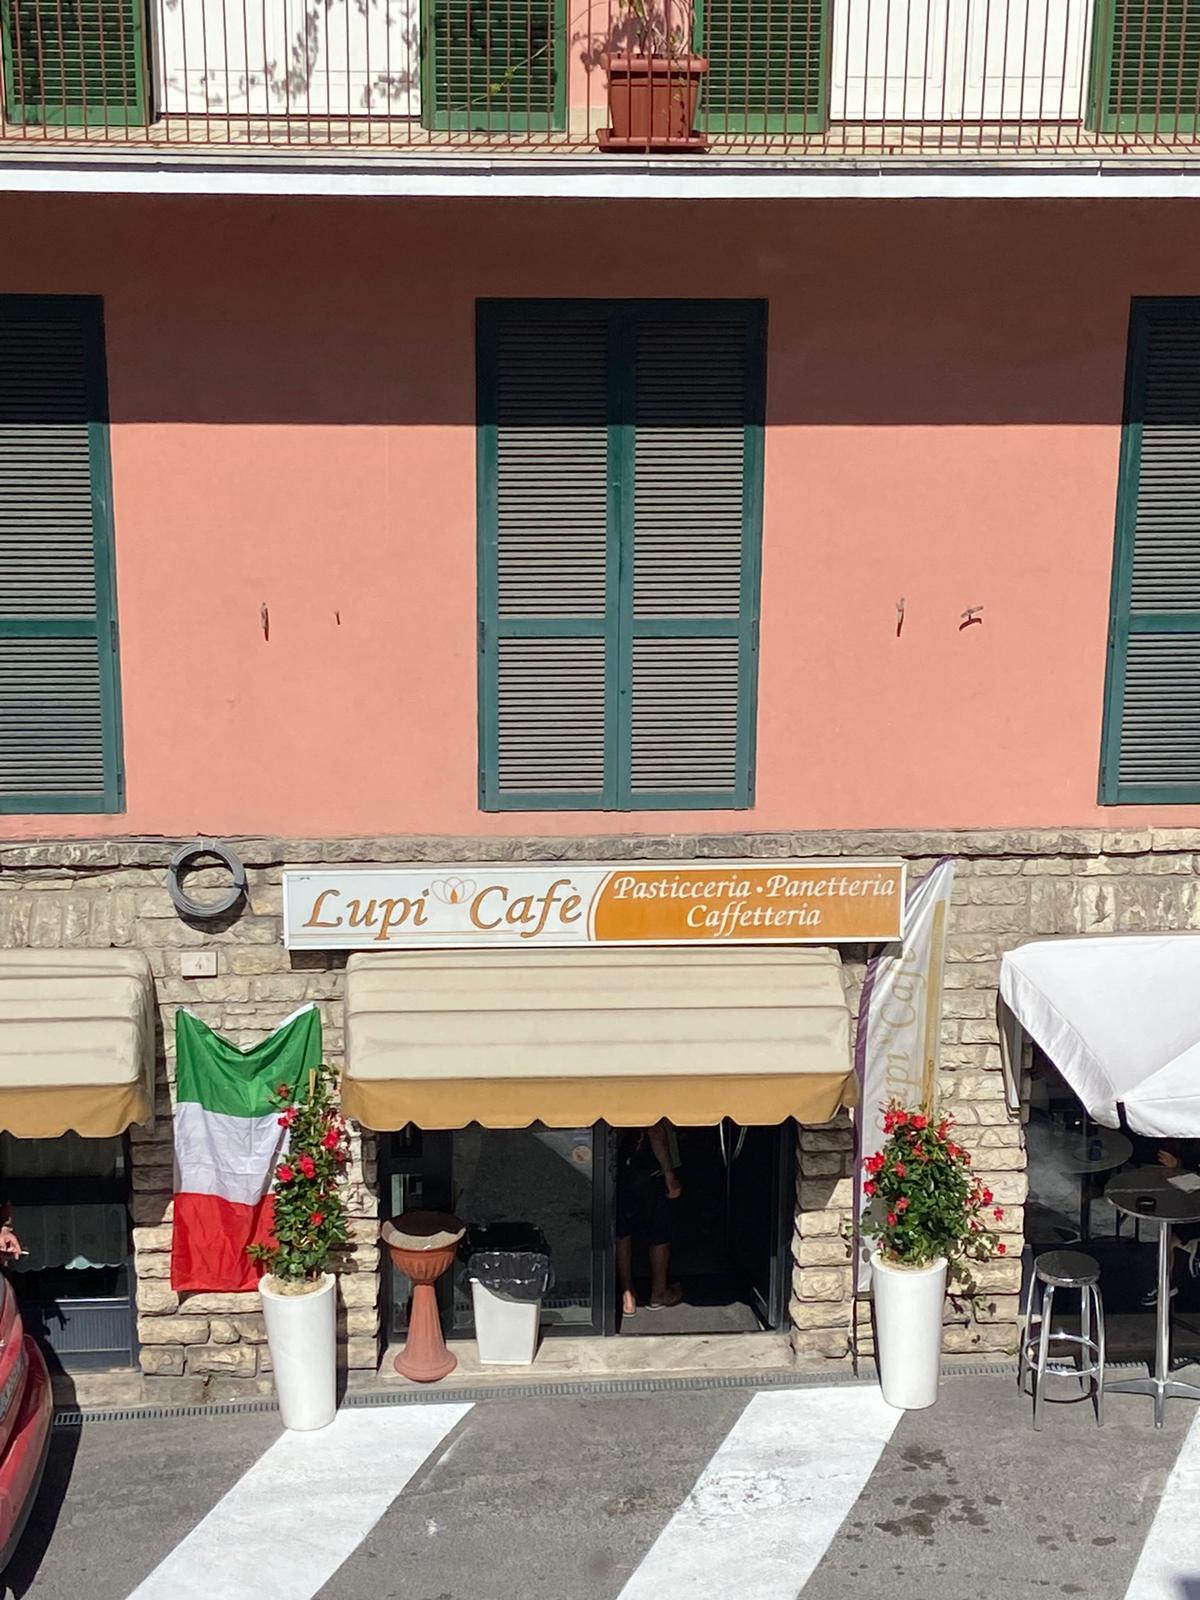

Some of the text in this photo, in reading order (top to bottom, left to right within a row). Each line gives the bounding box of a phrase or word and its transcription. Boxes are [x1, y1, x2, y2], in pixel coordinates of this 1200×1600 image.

[613, 873, 896, 899] Pasticceria Panetteria
[302, 888, 430, 941] Lupi
[686, 901, 822, 937] Caffetteria
